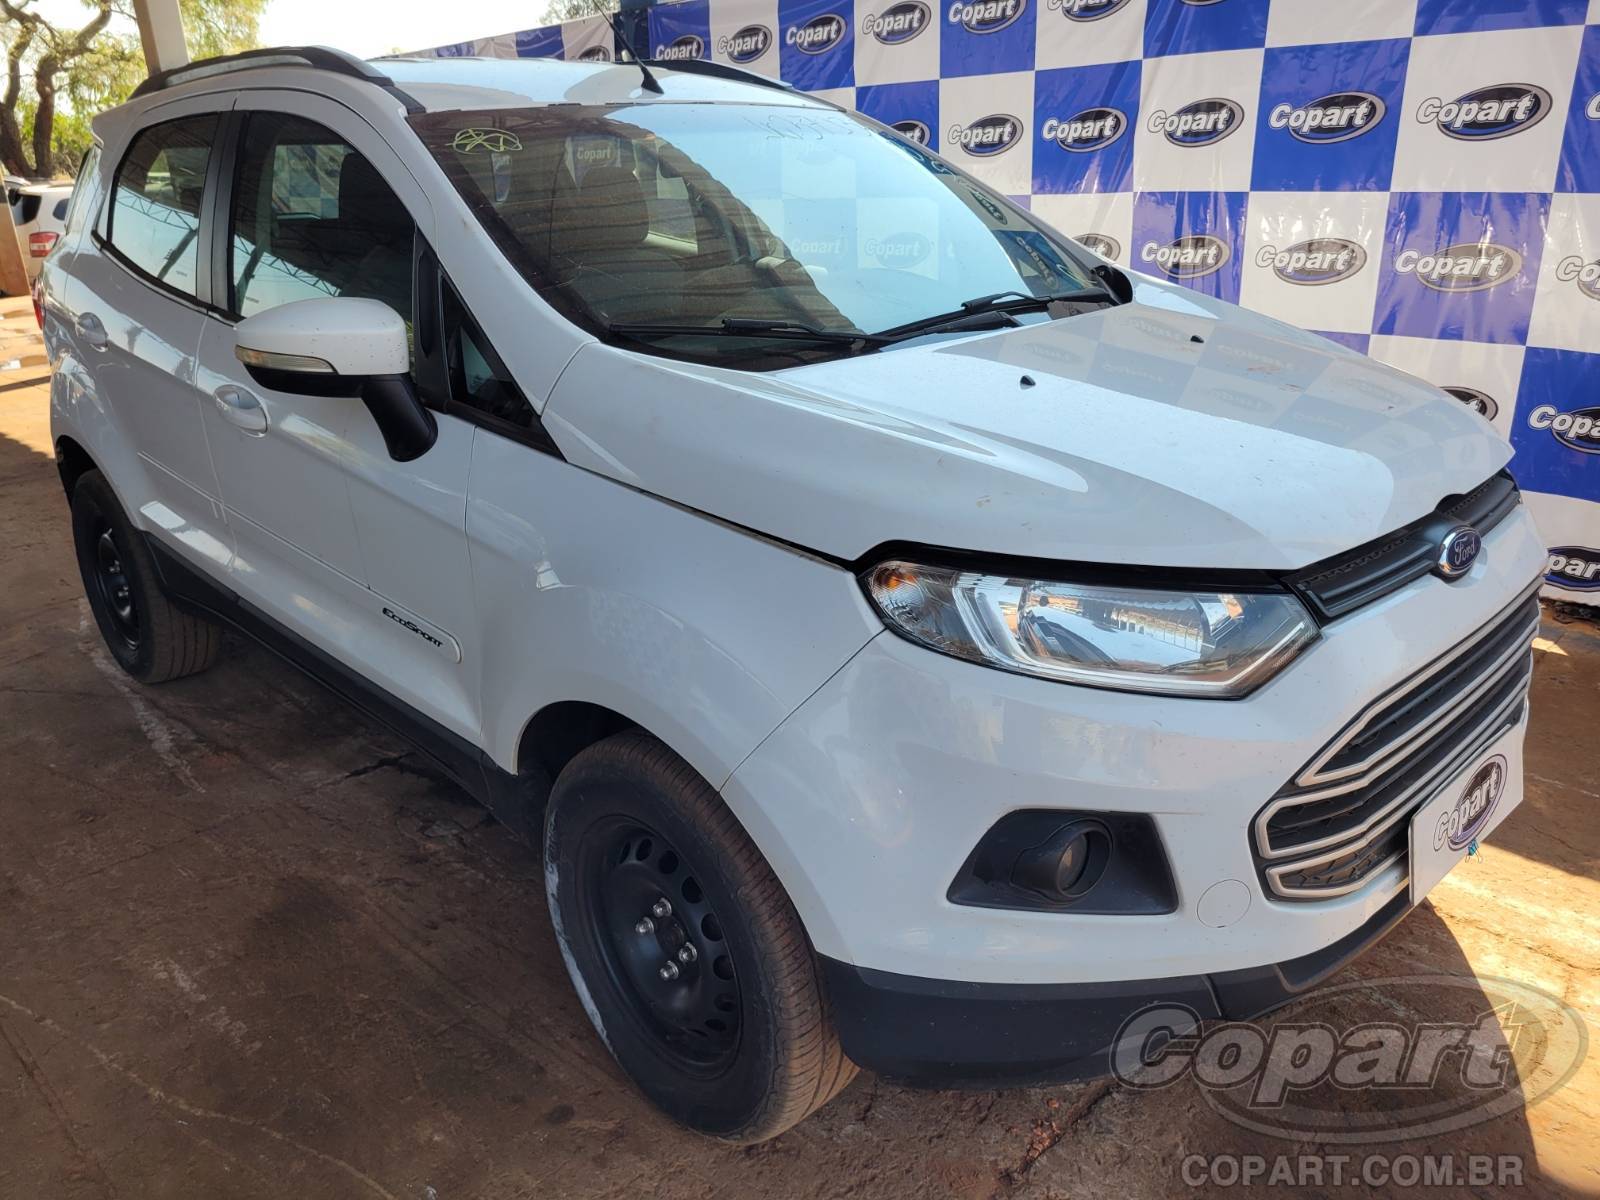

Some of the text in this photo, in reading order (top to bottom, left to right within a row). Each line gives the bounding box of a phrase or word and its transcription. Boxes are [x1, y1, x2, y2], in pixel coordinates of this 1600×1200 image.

[862, 12, 922, 39] Copart
[949, 0, 1016, 28] Copart
[717, 30, 765, 54] Copart
[786, 17, 840, 49] Copart
[655, 43, 698, 60] Copart
[1147, 104, 1231, 137] Copart
[1269, 97, 1373, 135] Copart
[1416, 91, 1535, 129] Copart
[948, 121, 1014, 149] Copart
[1042, 113, 1117, 142] Copart
[1141, 241, 1219, 270] Copart
[1255, 244, 1355, 276] Copart
[1395, 250, 1505, 281] Copart
[1528, 404, 1600, 440] Cop
[1454, 535, 1476, 564] Ford
[1433, 762, 1499, 852] Copart
